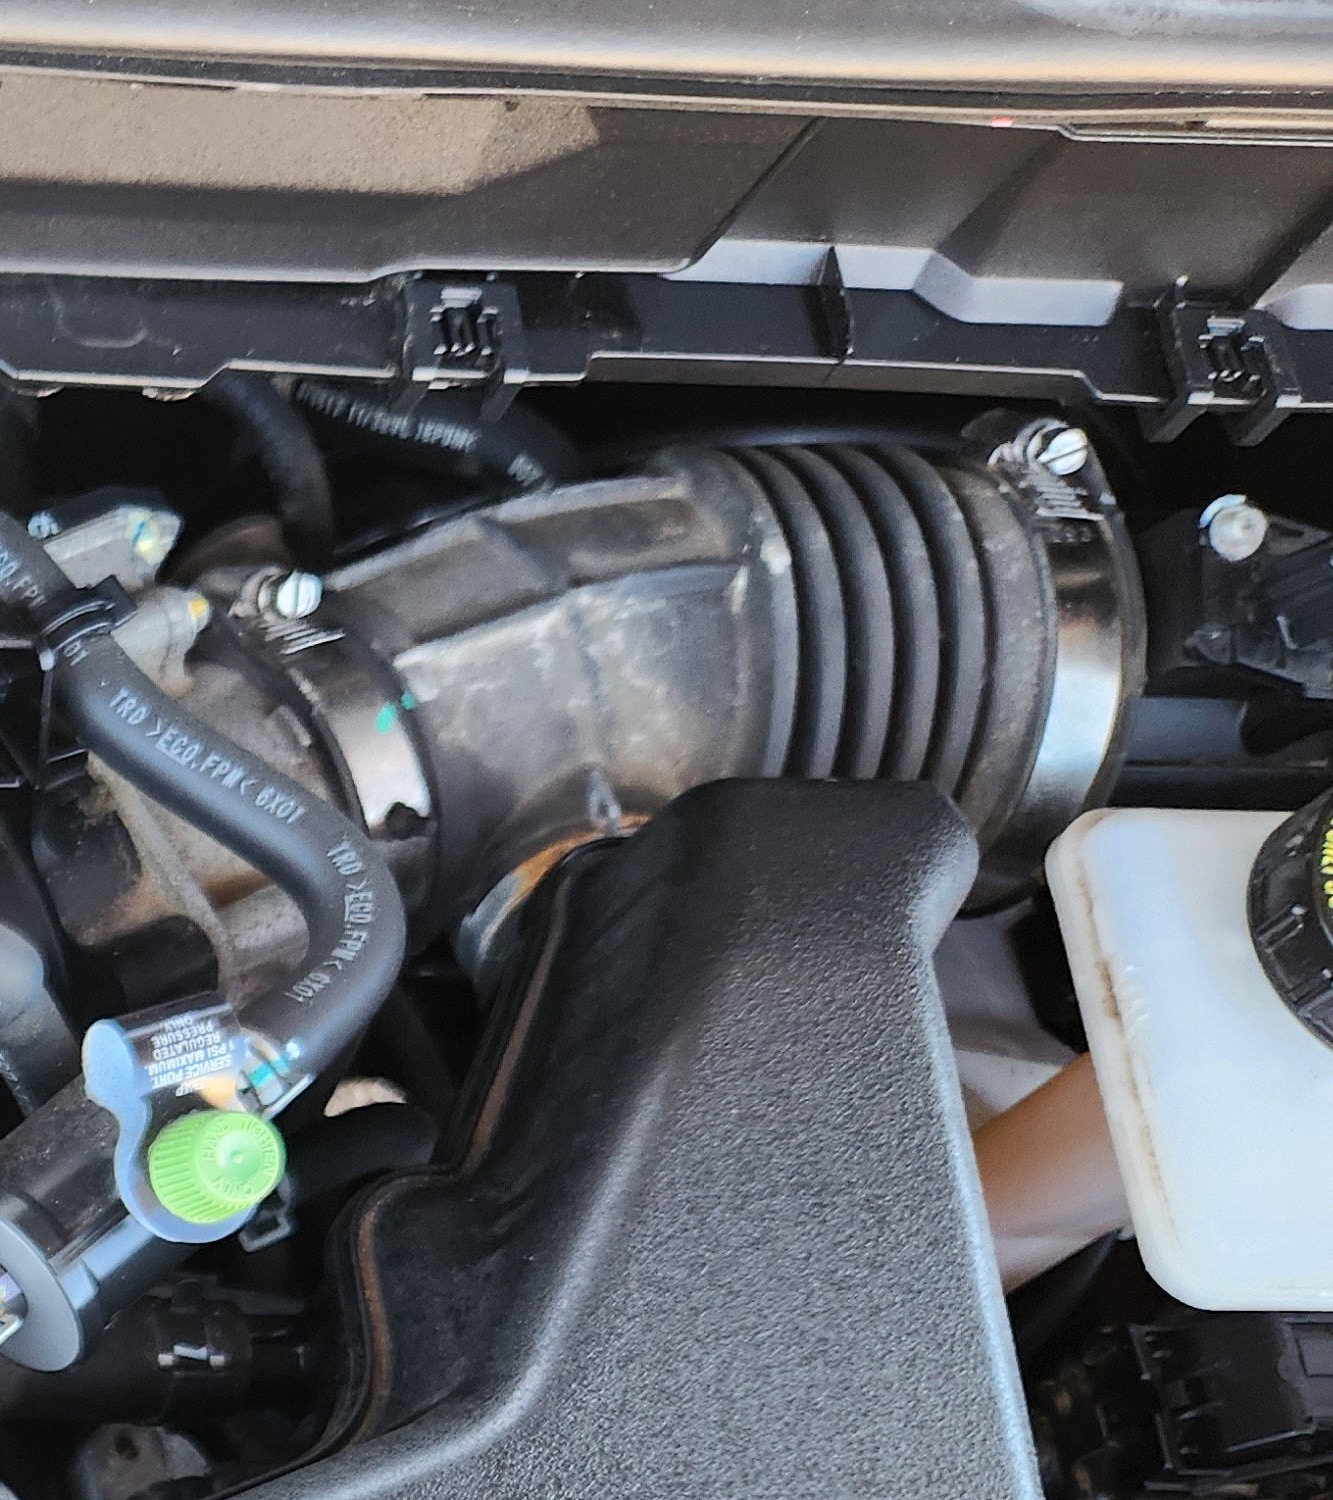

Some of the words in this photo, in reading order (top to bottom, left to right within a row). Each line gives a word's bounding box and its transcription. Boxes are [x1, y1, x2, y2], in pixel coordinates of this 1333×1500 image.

[150, 1019, 214, 1049] PRESSURE
[152, 1030, 221, 1061] REGULATED
[206, 1043, 227, 1058] PSI
[184, 1053, 232, 1078] SERVICE
